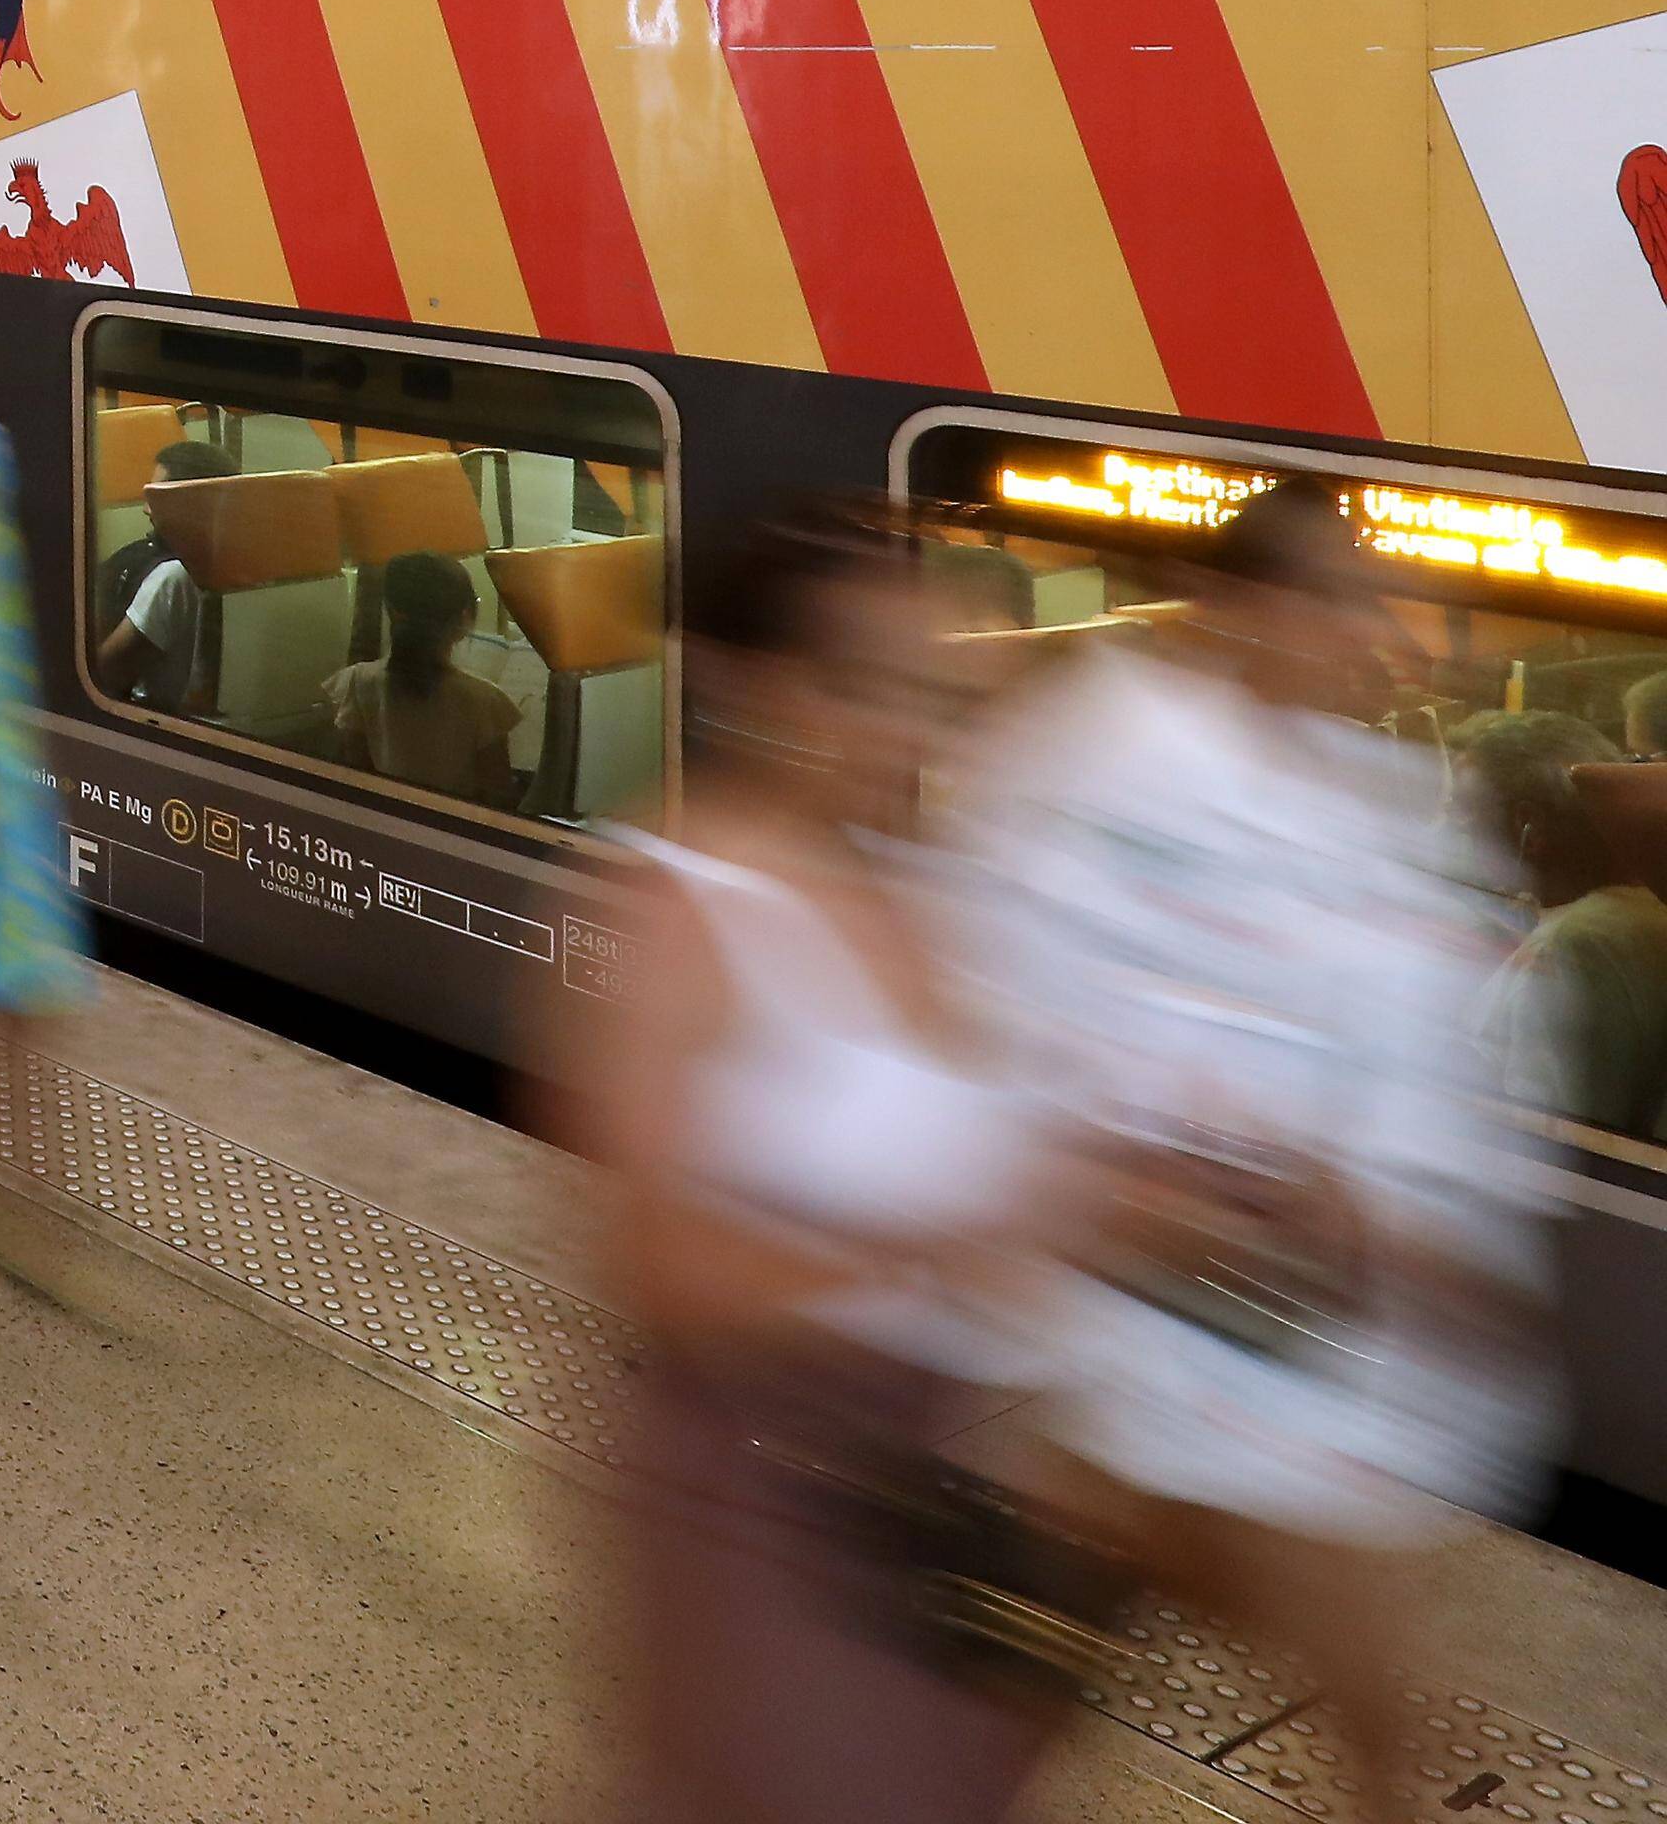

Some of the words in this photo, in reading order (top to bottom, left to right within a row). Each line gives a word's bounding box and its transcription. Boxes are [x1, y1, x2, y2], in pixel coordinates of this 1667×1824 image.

[80, 780, 104, 806] PA
[108, 790, 121, 810] E
[125, 794, 153, 825] Mg
[69, 834, 99, 888] F
[263, 821, 353, 872] 15.13m
[260, 878, 321, 907] LONGUEUR
[323, 899, 357, 920] RAME
